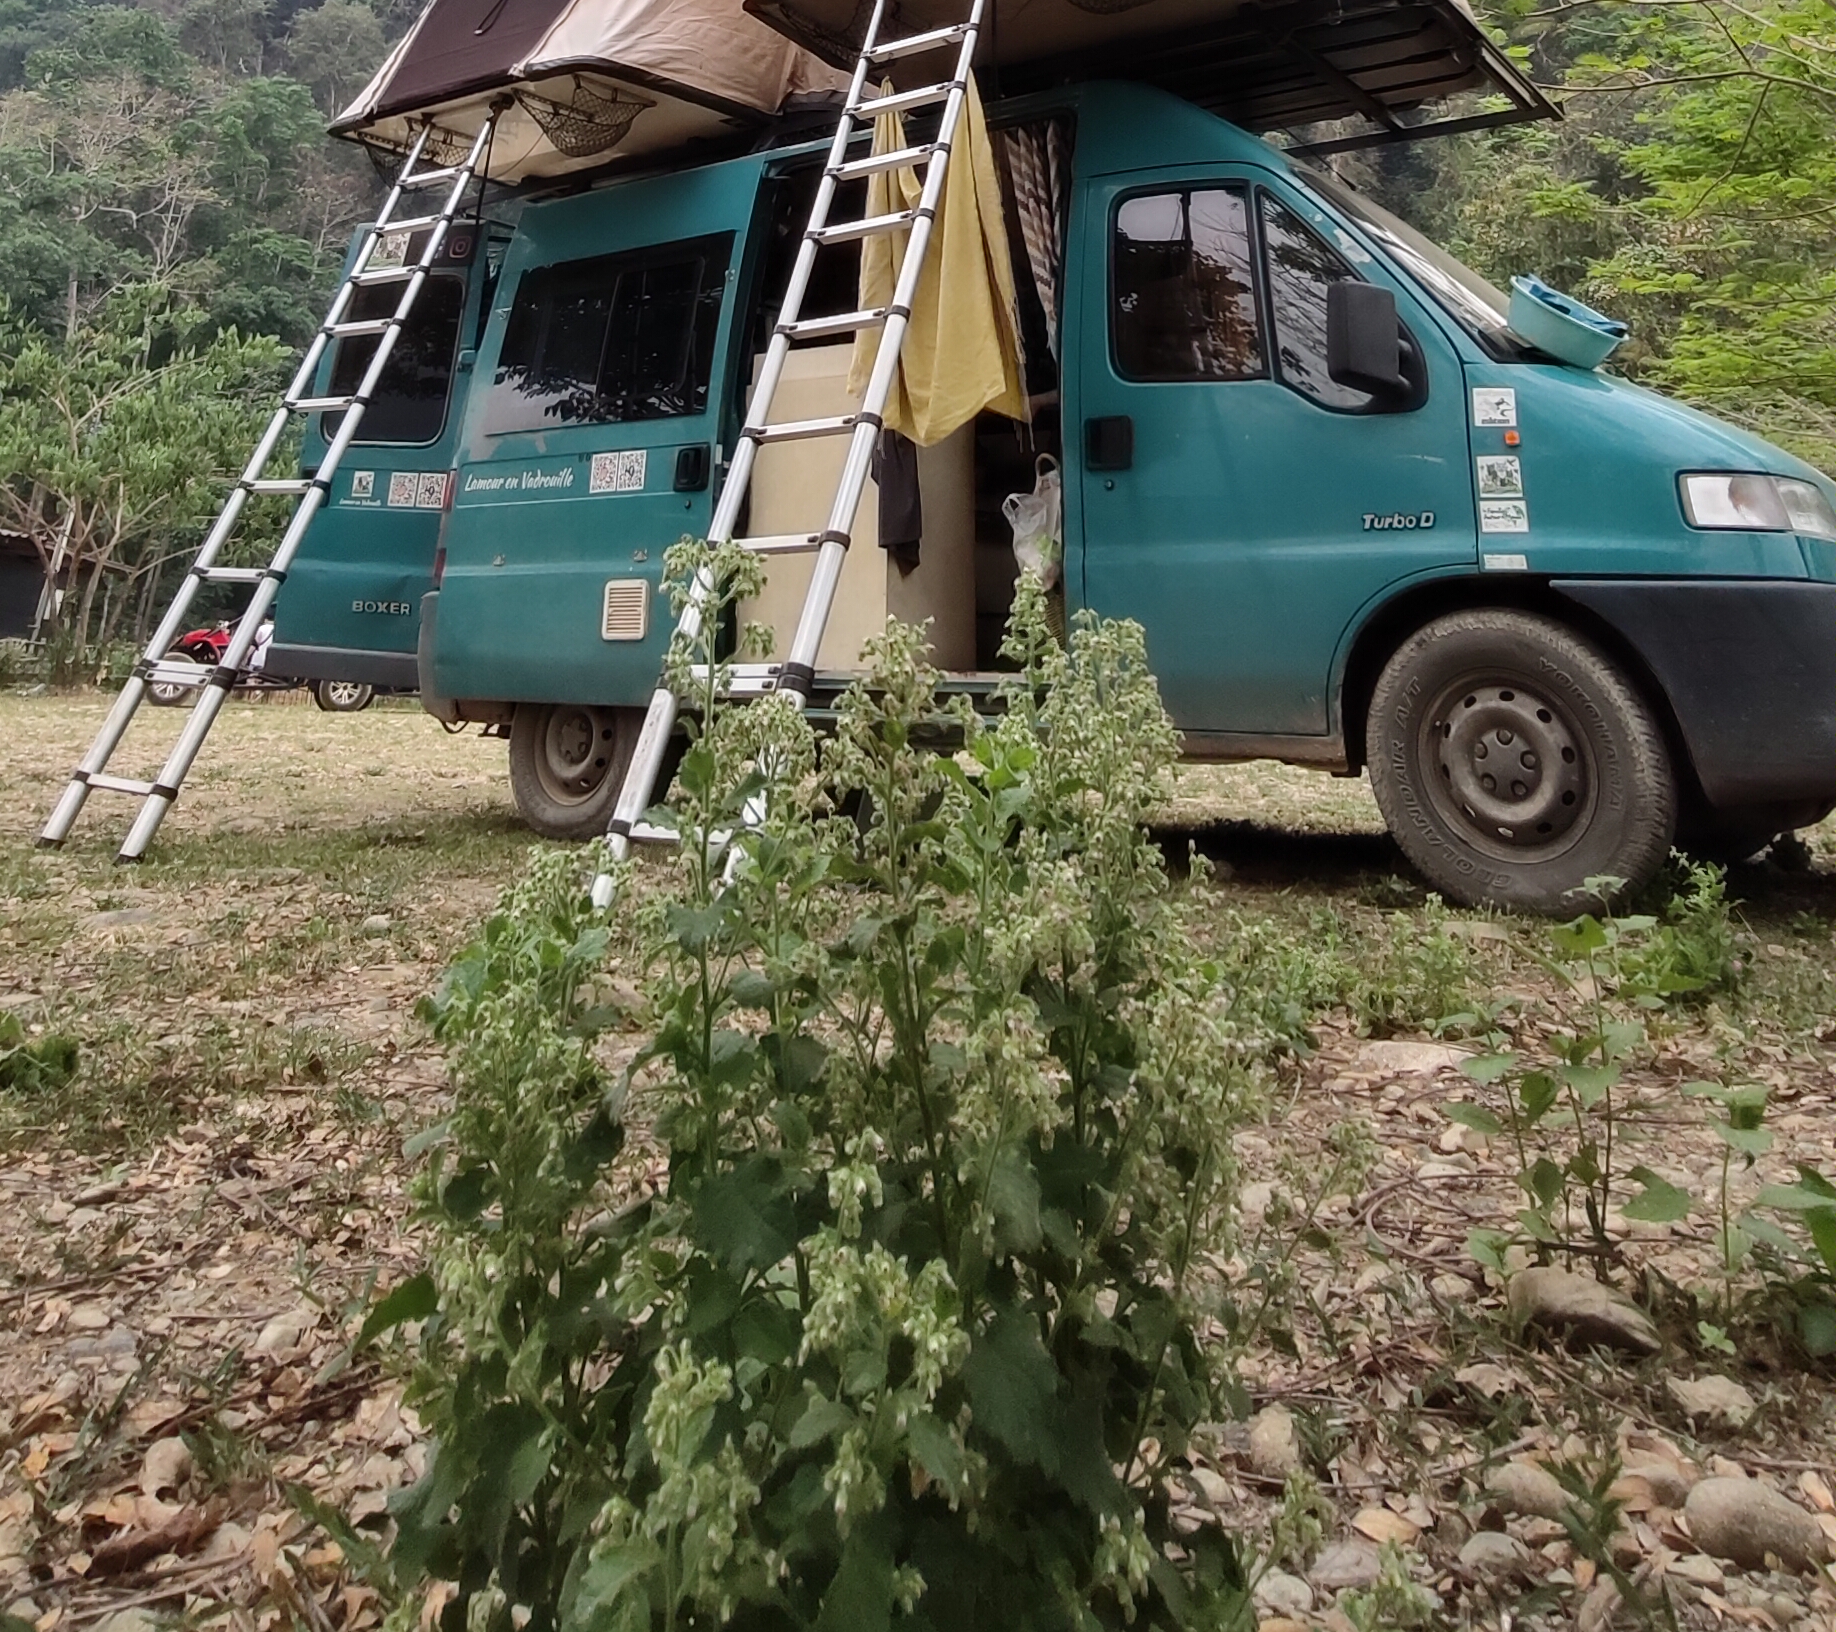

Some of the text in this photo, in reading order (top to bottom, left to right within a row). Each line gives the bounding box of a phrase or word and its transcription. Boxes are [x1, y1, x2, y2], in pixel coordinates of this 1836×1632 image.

[465, 467, 574, 491] Lamour en Vadrouille
[1362, 512, 1435, 530] Turbo D
[352, 600, 411, 615] BOXER
[1395, 675, 1422, 730] A/T
[1540, 656, 1623, 810] YOKOHAMA
